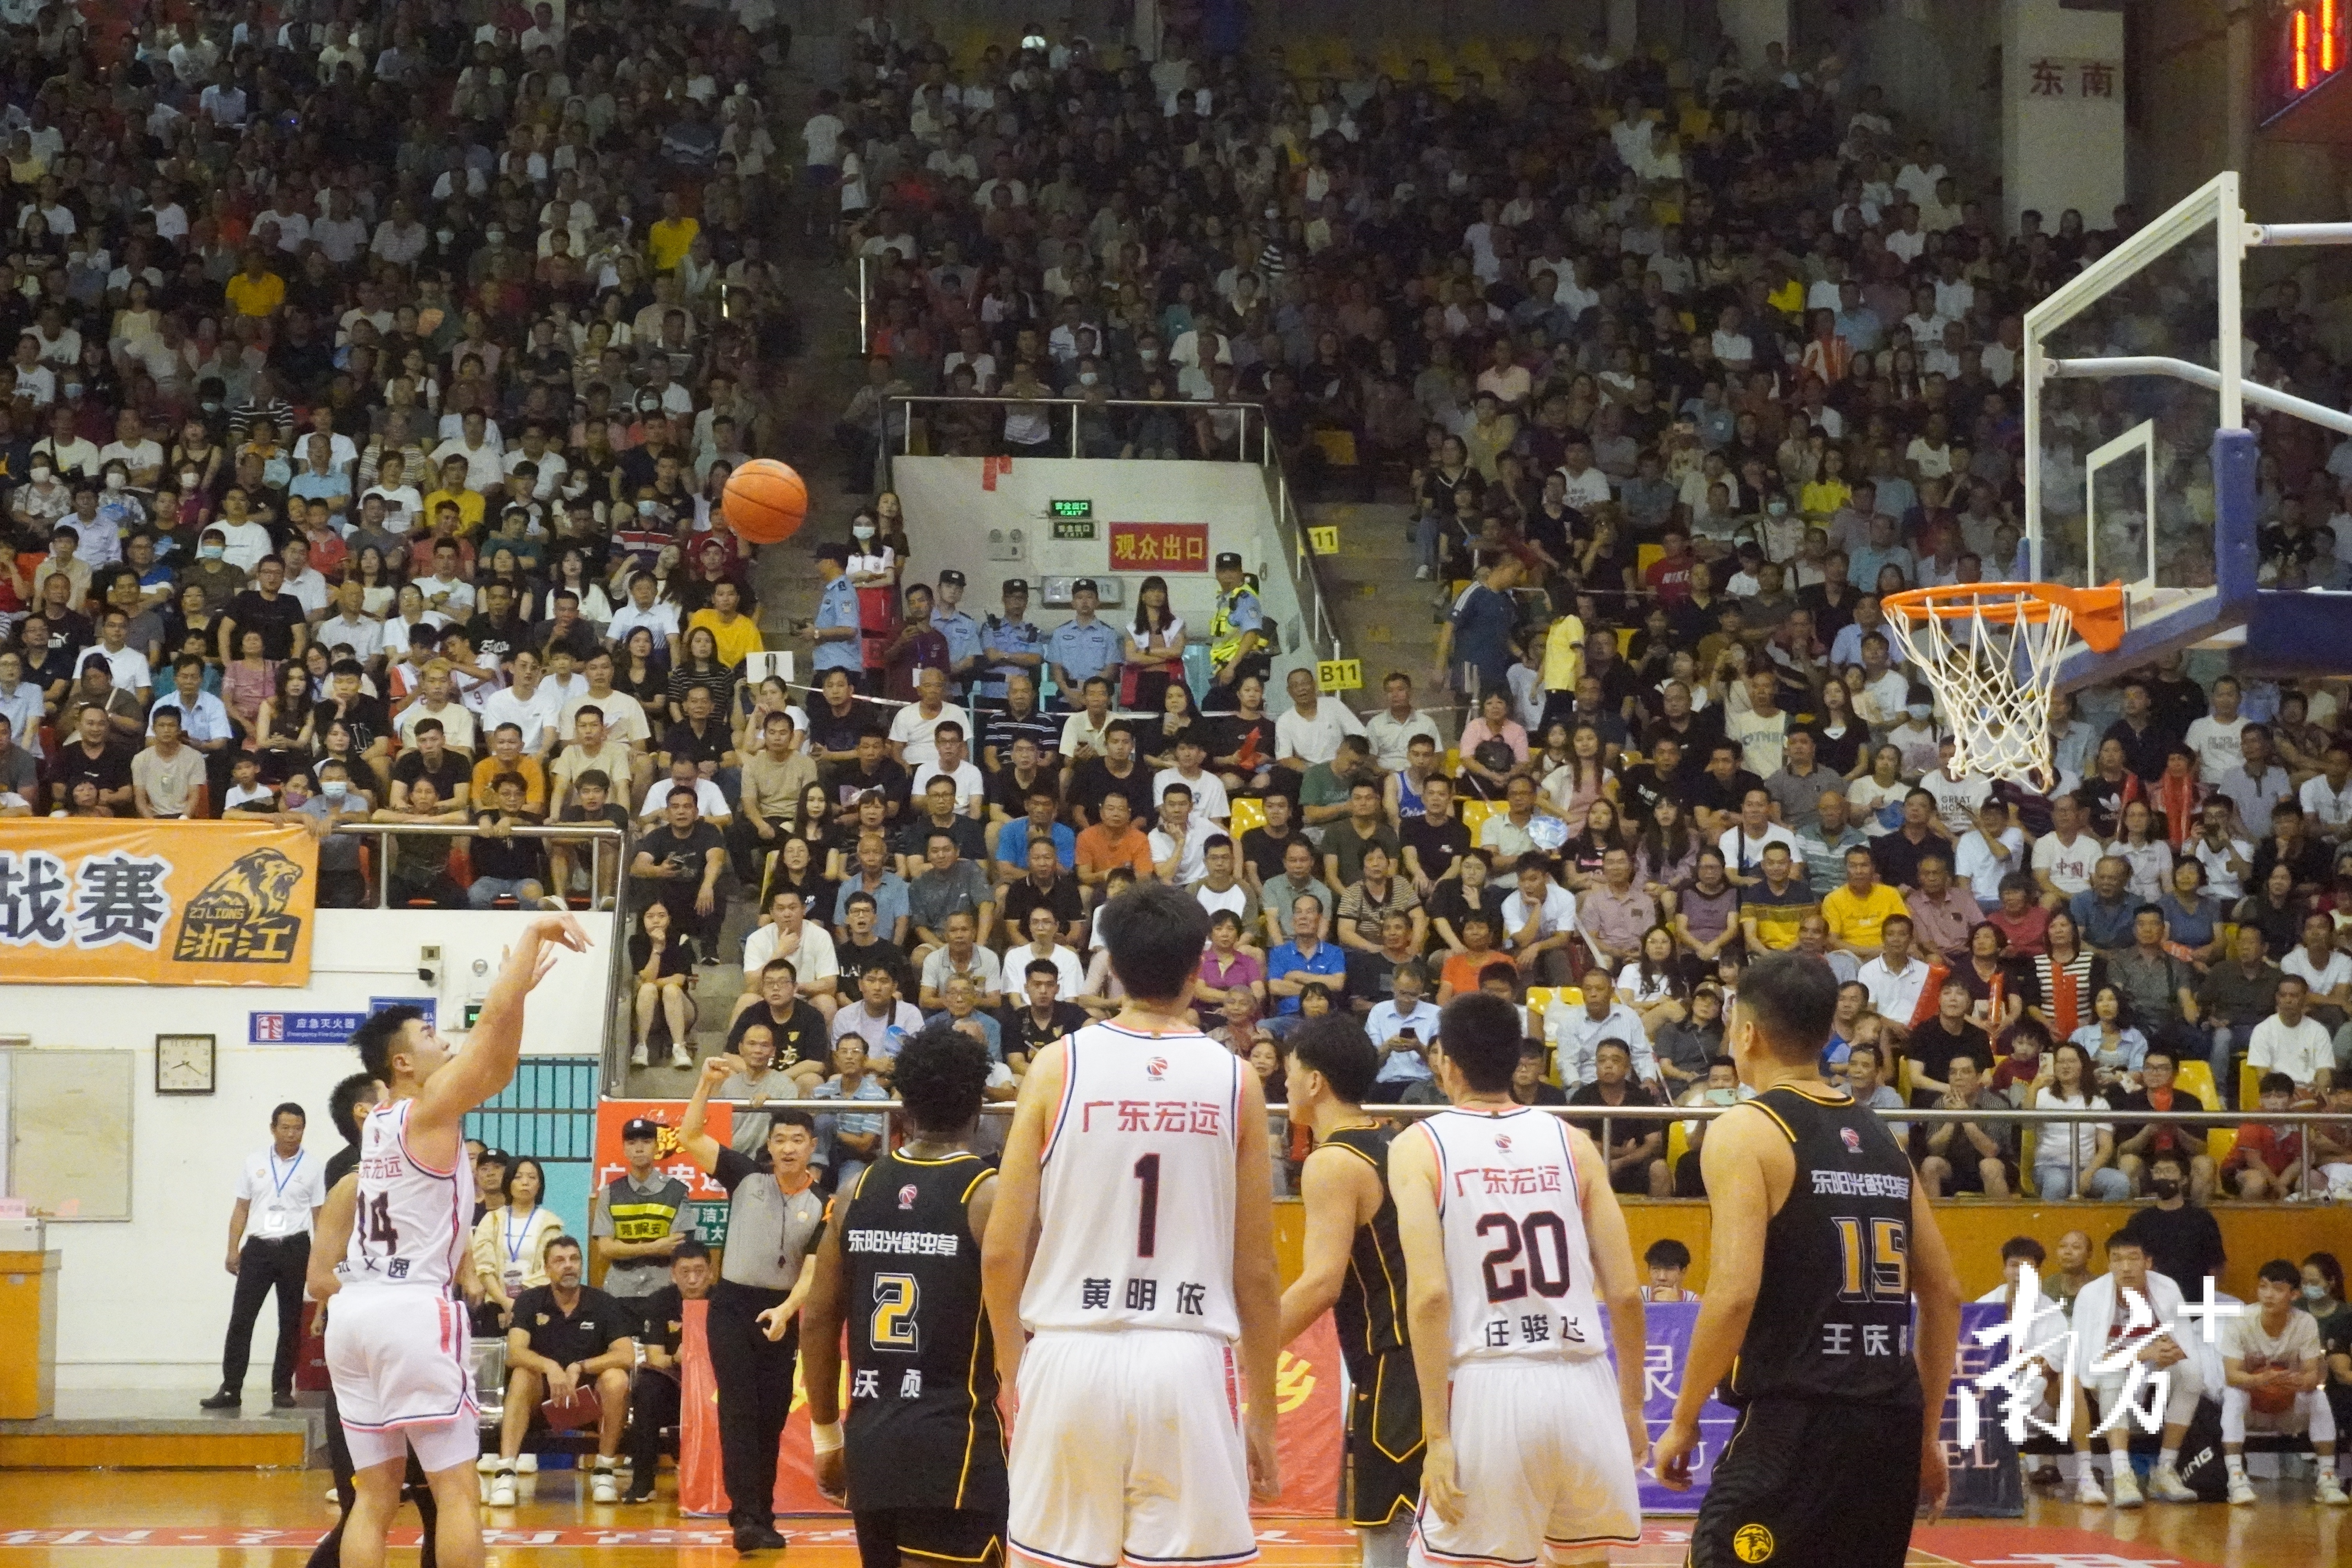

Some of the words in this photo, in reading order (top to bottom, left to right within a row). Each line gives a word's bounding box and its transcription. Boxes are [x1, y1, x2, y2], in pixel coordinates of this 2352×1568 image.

[2029, 58, 2115, 98] 东南
[1115, 533, 1203, 560] 观众出口
[1321, 664, 1357, 682] B11
[179, 923, 292, 959] 浙江
[1082, 1100, 1220, 1136] 广东宏远
[1454, 1165, 1561, 1197] 广东宏远
[1810, 1169, 1909, 1200] 东阳光鲜虫草
[358, 1189, 399, 1257] 14
[1133, 1152, 1161, 1258] 1
[848, 1229, 958, 1256] 东阳光鲜虫草
[1475, 1210, 1570, 1304] 20
[1830, 1216, 1909, 1305] 15
[870, 1272, 919, 1353] 2
[1082, 1277, 1206, 1316] 黄明依
[1484, 1314, 1585, 1347] 任骏飞
[1822, 1323, 1907, 1357] 王庆
